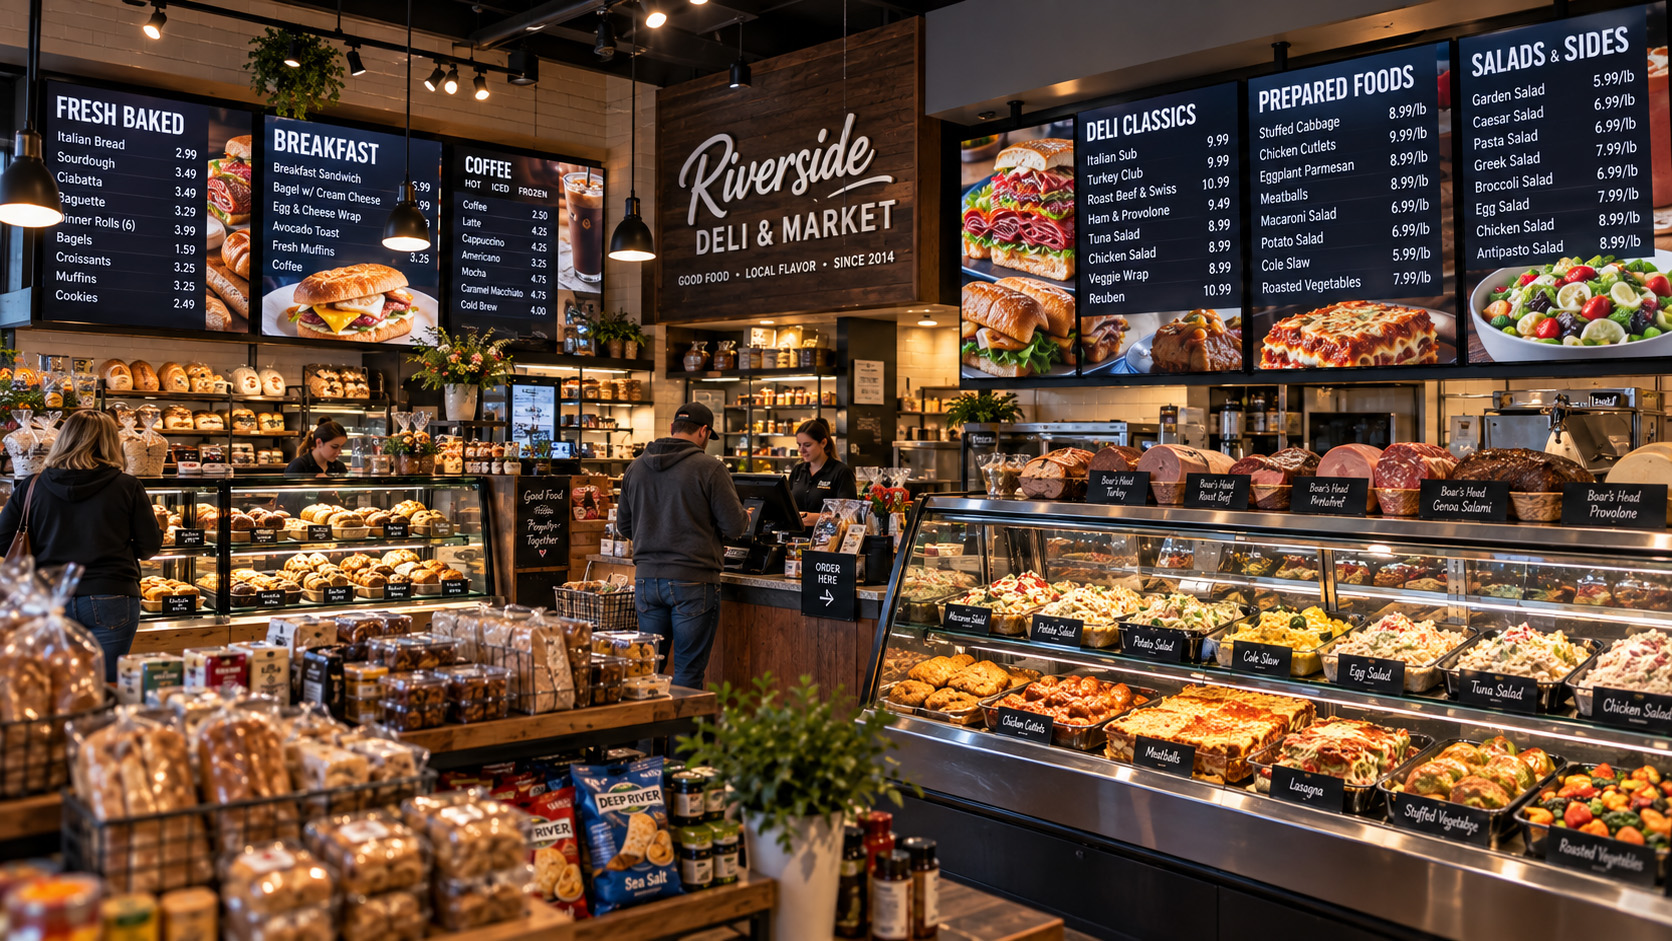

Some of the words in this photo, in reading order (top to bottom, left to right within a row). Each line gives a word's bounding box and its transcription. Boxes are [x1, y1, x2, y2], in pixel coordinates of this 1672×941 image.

[1472, 41, 1545, 77] SALADS
[1550, 49, 1560, 63] &
[1564, 26, 1629, 61] SIDES
[1259, 77, 1347, 113] PREPARED
[1354, 64, 1414, 97] FOODS
[1472, 90, 1511, 106] Garden
[1514, 83, 1545, 99] Salad
[57, 95, 116, 126] FRESH
[123, 105, 184, 135] BAKED
[1087, 117, 1118, 142] DELI
[1123, 103, 1196, 135] CLASSICS
[1473, 114, 1511, 128] Caesar
[1513, 105, 1544, 122] Salad
[1259, 122, 1293, 139] Stuffed
[1296, 118, 1340, 133] Cabbage
[58, 131, 91, 145] Italian
[95, 136, 125, 150] Bread
[176, 147, 197, 160] 2.99
[274, 128, 379, 165] BREAKFAST
[1087, 153, 1116, 166] Italian
[1119, 148, 1137, 161] Sub
[1207, 133, 1229, 148] 9.99
[1474, 137, 1504, 150] Pasta
[1507, 129, 1538, 145] Salad
[1259, 146, 1298, 161] Chicken
[1300, 140, 1336, 155] Cutlets
[1474, 156, 1507, 171] Greek
[1510, 151, 1540, 167] Salad
[57, 151, 115, 170] Sourdough
[175, 167, 197, 179] 3.49
[274, 162, 316, 178] Breakfast
[319, 168, 361, 184] Sandwich
[465, 156, 512, 179] COFFEE
[679, 113, 878, 229] Riverside
[1087, 172, 1119, 185] Turkey
[1121, 167, 1143, 181] Club
[1207, 154, 1229, 168] 9.99
[1260, 167, 1302, 185] Eggplant
[1305, 161, 1354, 176] Parmesan
[57, 171, 102, 187] Ciabatta
[175, 186, 196, 198] 3.49
[273, 181, 299, 196] Bagel
[302, 186, 315, 197] w/
[316, 187, 346, 201] Cream
[348, 191, 381, 205] Cheese
[465, 179, 481, 189] HOT
[492, 183, 509, 193] ICED
[518, 187, 547, 198] FROZEN
[1088, 193, 1114, 205] Roast
[1116, 187, 1137, 201] Beef
[1139, 187, 1147, 198] &
[1149, 183, 1177, 197] Swiss
[1202, 175, 1230, 190] 10.99
[1475, 176, 1519, 193] Broccoli
[1522, 172, 1553, 187] Salad
[58, 191, 105, 207] Baguette
[175, 205, 196, 217] 3.29
[463, 200, 487, 212] Coffee
[1260, 188, 1308, 205] Meatballs
[1476, 203, 1496, 217] Egg
[1499, 197, 1529, 212] Salad
[273, 201, 290, 215] Egg
[293, 203, 300, 214] &
[302, 205, 336, 218] Cheese
[338, 209, 361, 223] Wrap
[1088, 214, 1110, 225] Ham
[1112, 210, 1119, 222] &
[1122, 206, 1170, 221] Provolone
[1208, 197, 1230, 211] 9.49
[1261, 210, 1306, 227] Macaroni
[1309, 207, 1336, 222] Salad
[95, 216, 119, 229] Rolls
[122, 219, 135, 232] (6)
[174, 224, 196, 236] 3.99
[272, 221, 313, 235] Avocado
[315, 226, 339, 238] Toast
[462, 217, 482, 228] Latte
[696, 223, 747, 255] DELI
[757, 219, 773, 246] &
[783, 199, 896, 243] MARKET
[1088, 233, 1111, 244] Tuna
[1114, 228, 1140, 242] Salad
[1208, 218, 1230, 232] 8.99
[1476, 223, 1520, 237] Chicken
[1523, 217, 1554, 233] Salad
[57, 232, 92, 246] Bagels
[175, 244, 195, 255] 1.59
[273, 240, 298, 252] Fresh
[301, 243, 335, 256] Muffins
[1261, 236, 1293, 249] Potato
[1296, 231, 1323, 246] Salad
[1477, 245, 1530, 260] Antipasto
[1533, 240, 1564, 255] Salad
[56, 251, 111, 266] Croissants
[174, 262, 195, 273] 3.25
[410, 252, 429, 264] 3.25
[1088, 251, 1126, 264] Chicken
[1129, 246, 1156, 260] Salad
[1209, 240, 1231, 253] 8.99
[272, 259, 303, 272] Coffee
[678, 274, 703, 286] GOOD
[705, 271, 729, 283] FOOD
[746, 265, 776, 278] LOCAL
[779, 260, 816, 274] FLAVOR
[834, 254, 865, 269] SINCE
[868, 250, 894, 265] 2014
[1088, 271, 1121, 286] Veggie
[1123, 269, 1149, 282] Wrap
[1209, 261, 1231, 274] 8.99
[1261, 258, 1284, 272] Cole
[1286, 257, 1310, 269] Slaw
[56, 270, 97, 284] Muffins
[174, 280, 195, 291] 3.25
[1262, 279, 1302, 294] Roasted
[1304, 276, 1361, 293] Vegetables
[55, 289, 98, 303] Cookies
[174, 298, 195, 309] 2.49
[1089, 292, 1125, 304] Reuben
[1204, 283, 1231, 296] 10.99
[461, 300, 478, 310] Cold
[479, 301, 498, 311] Brew
[545, 489, 563, 500] Food
[1587, 489, 1614, 502] Boar's
[1617, 490, 1641, 503] Head
[1433, 499, 1459, 512] Genoa
[1461, 500, 1492, 513] Salami
[1589, 504, 1637, 519] Provolone
[526, 534, 558, 549] Together
[815, 562, 840, 574] ORDER
[818, 574, 837, 585] HERE
[1243, 650, 1259, 663] Cole
[1260, 652, 1280, 666] Slaw
[1349, 664, 1366, 682] Egg
[1367, 666, 1392, 681] Salad
[1471, 680, 1493, 696] Tuna
[1495, 683, 1524, 700] Salad
[1603, 698, 1641, 716] Chicken
[1643, 703, 1672, 720] Salad
[598, 794, 626, 808] DEEP
[627, 789, 661, 805] RIVER
[1289, 777, 1324, 799] Lasagna
[1404, 804, 1437, 823] Stuffed
[534, 823, 571, 839] RIVER
[624, 875, 645, 892] Sea
[646, 869, 667, 887] Salt
